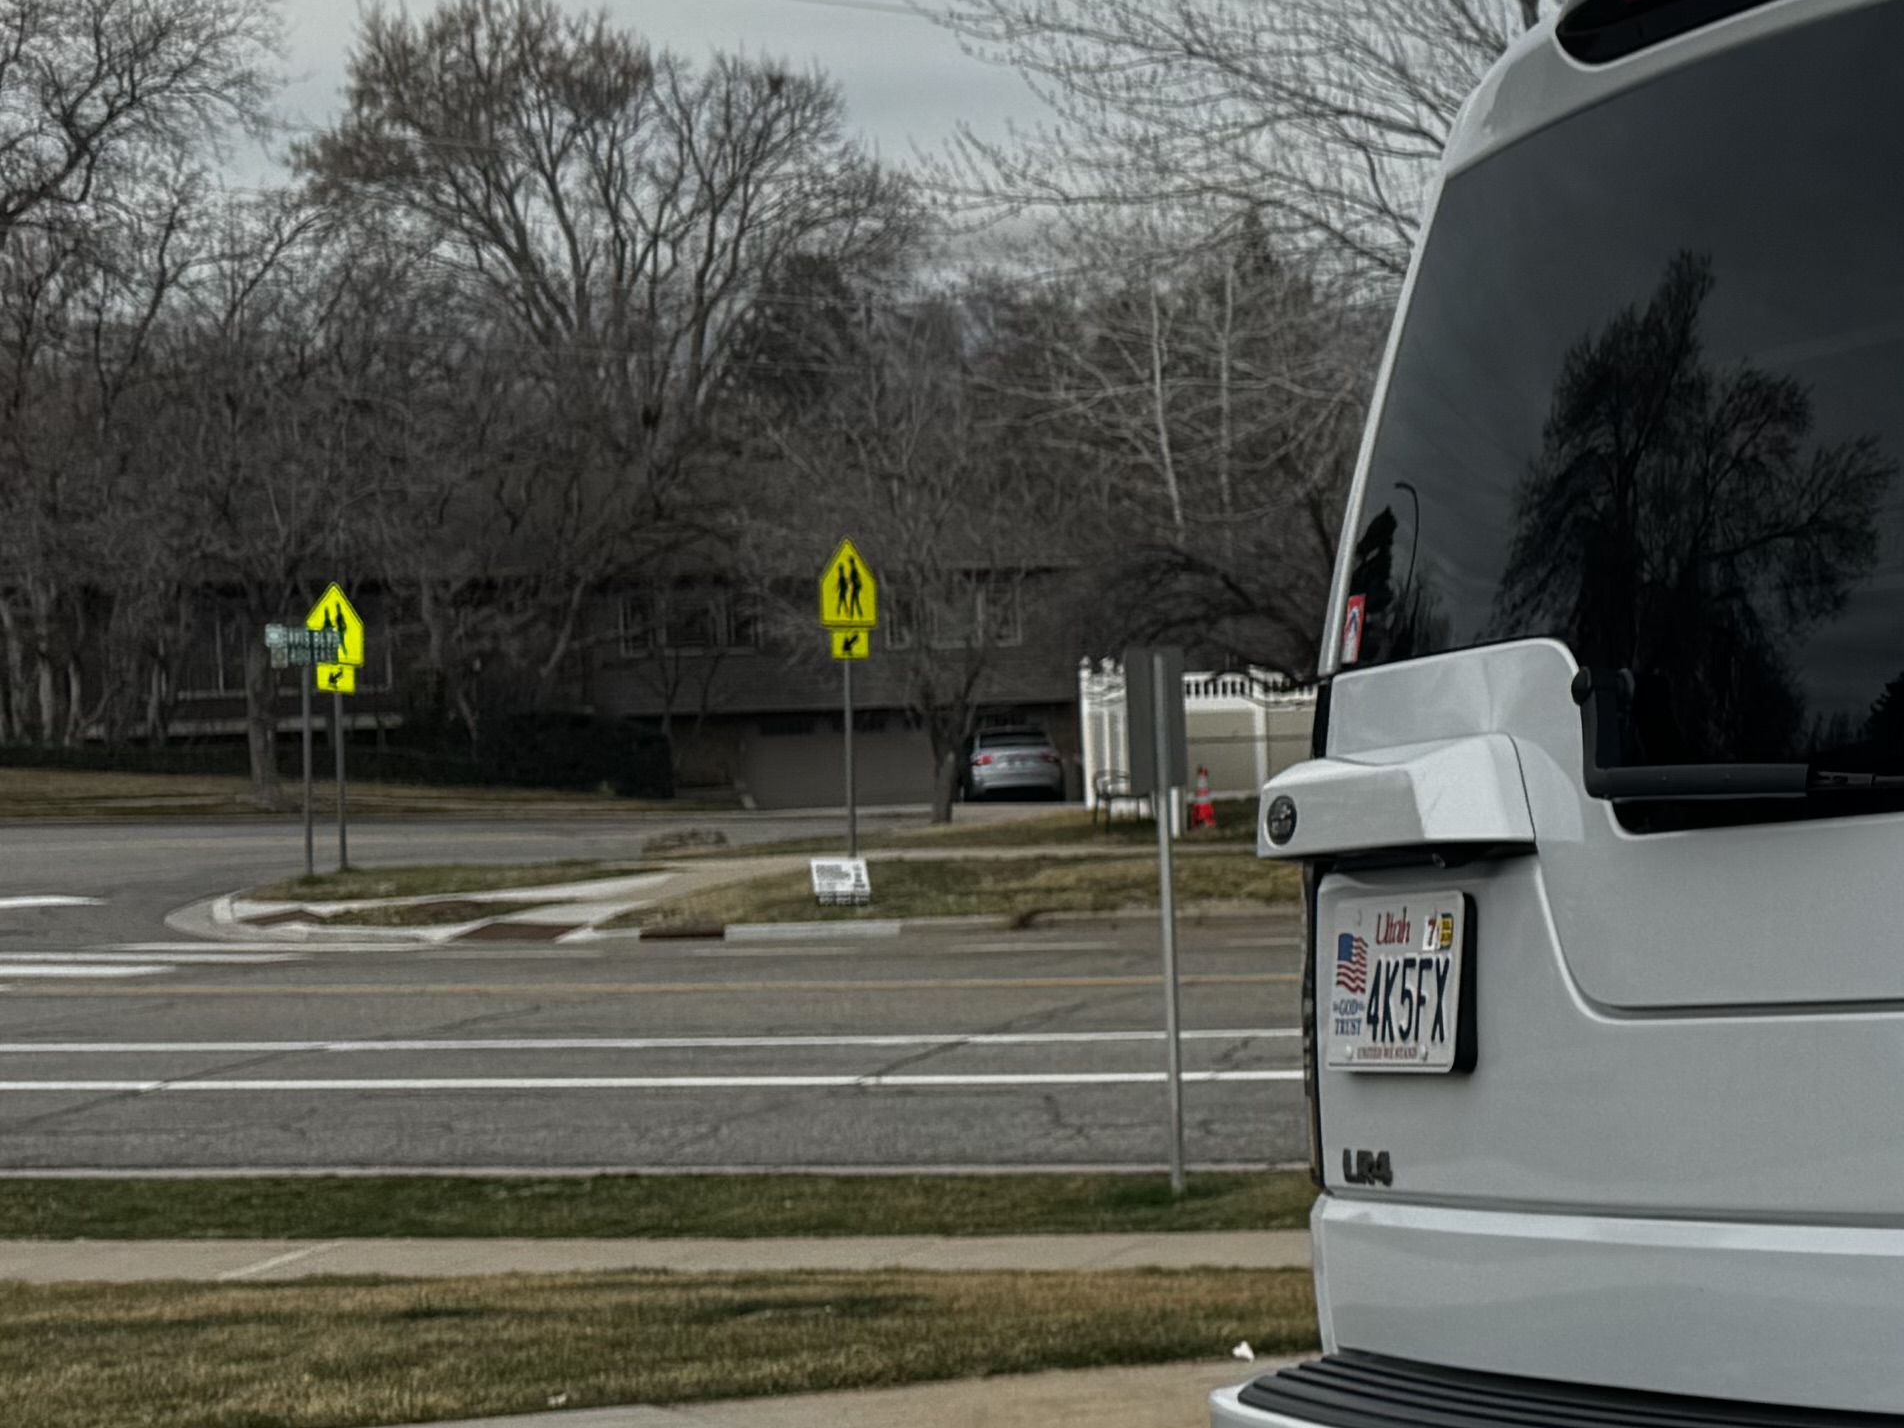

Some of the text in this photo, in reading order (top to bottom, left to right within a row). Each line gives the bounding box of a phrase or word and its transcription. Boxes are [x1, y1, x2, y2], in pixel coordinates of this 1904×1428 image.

[1376, 906, 1411, 945] Utah
[1366, 958, 1450, 1042] 4K5FX
[1335, 1018, 1362, 1036] TRUST
[1342, 1148, 1393, 1187] LR4
